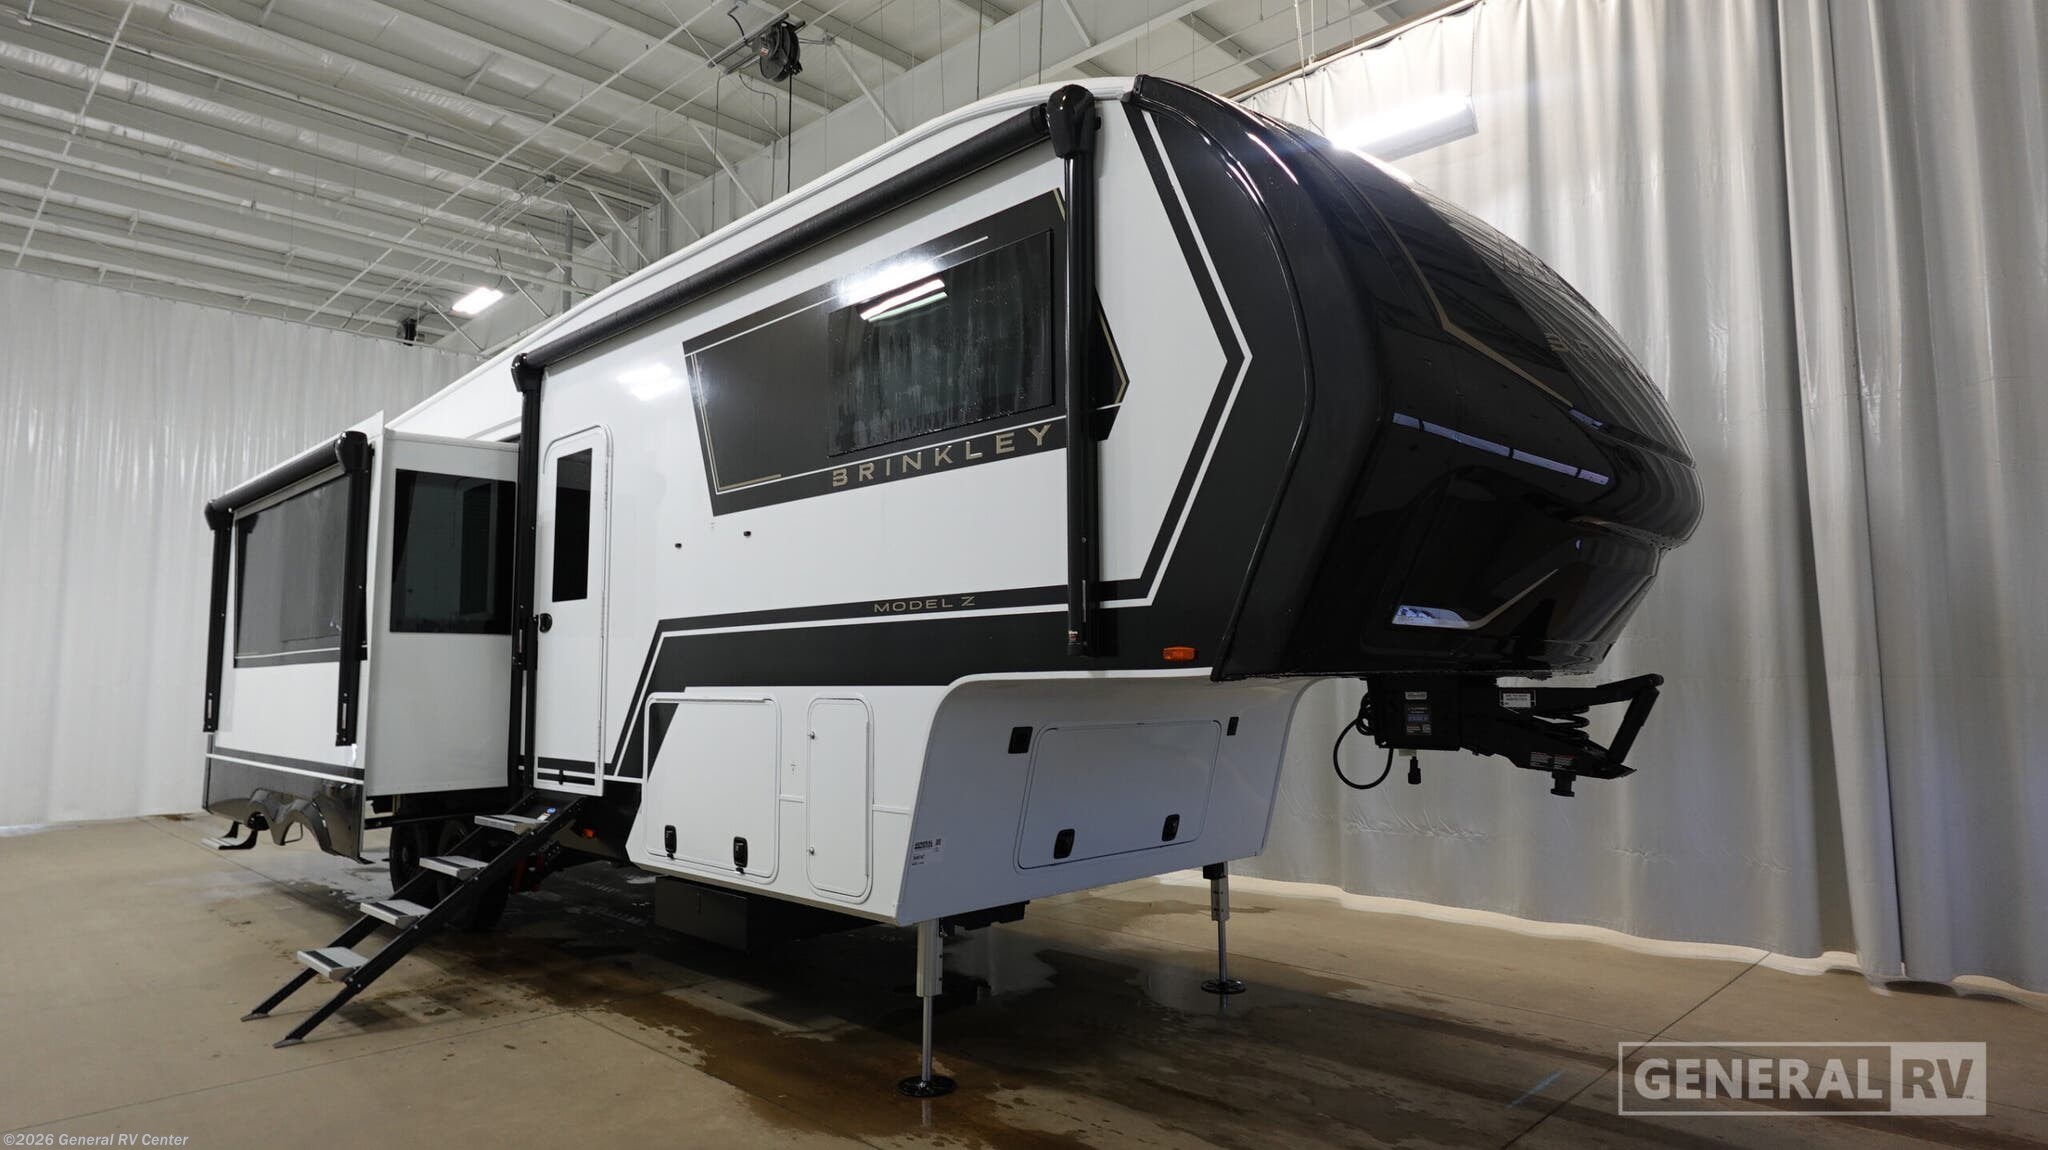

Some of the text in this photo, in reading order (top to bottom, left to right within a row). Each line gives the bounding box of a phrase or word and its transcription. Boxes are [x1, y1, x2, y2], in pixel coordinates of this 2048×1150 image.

[832, 424, 1052, 487] BRINKLEY
[873, 595, 976, 613] MODEL Z
